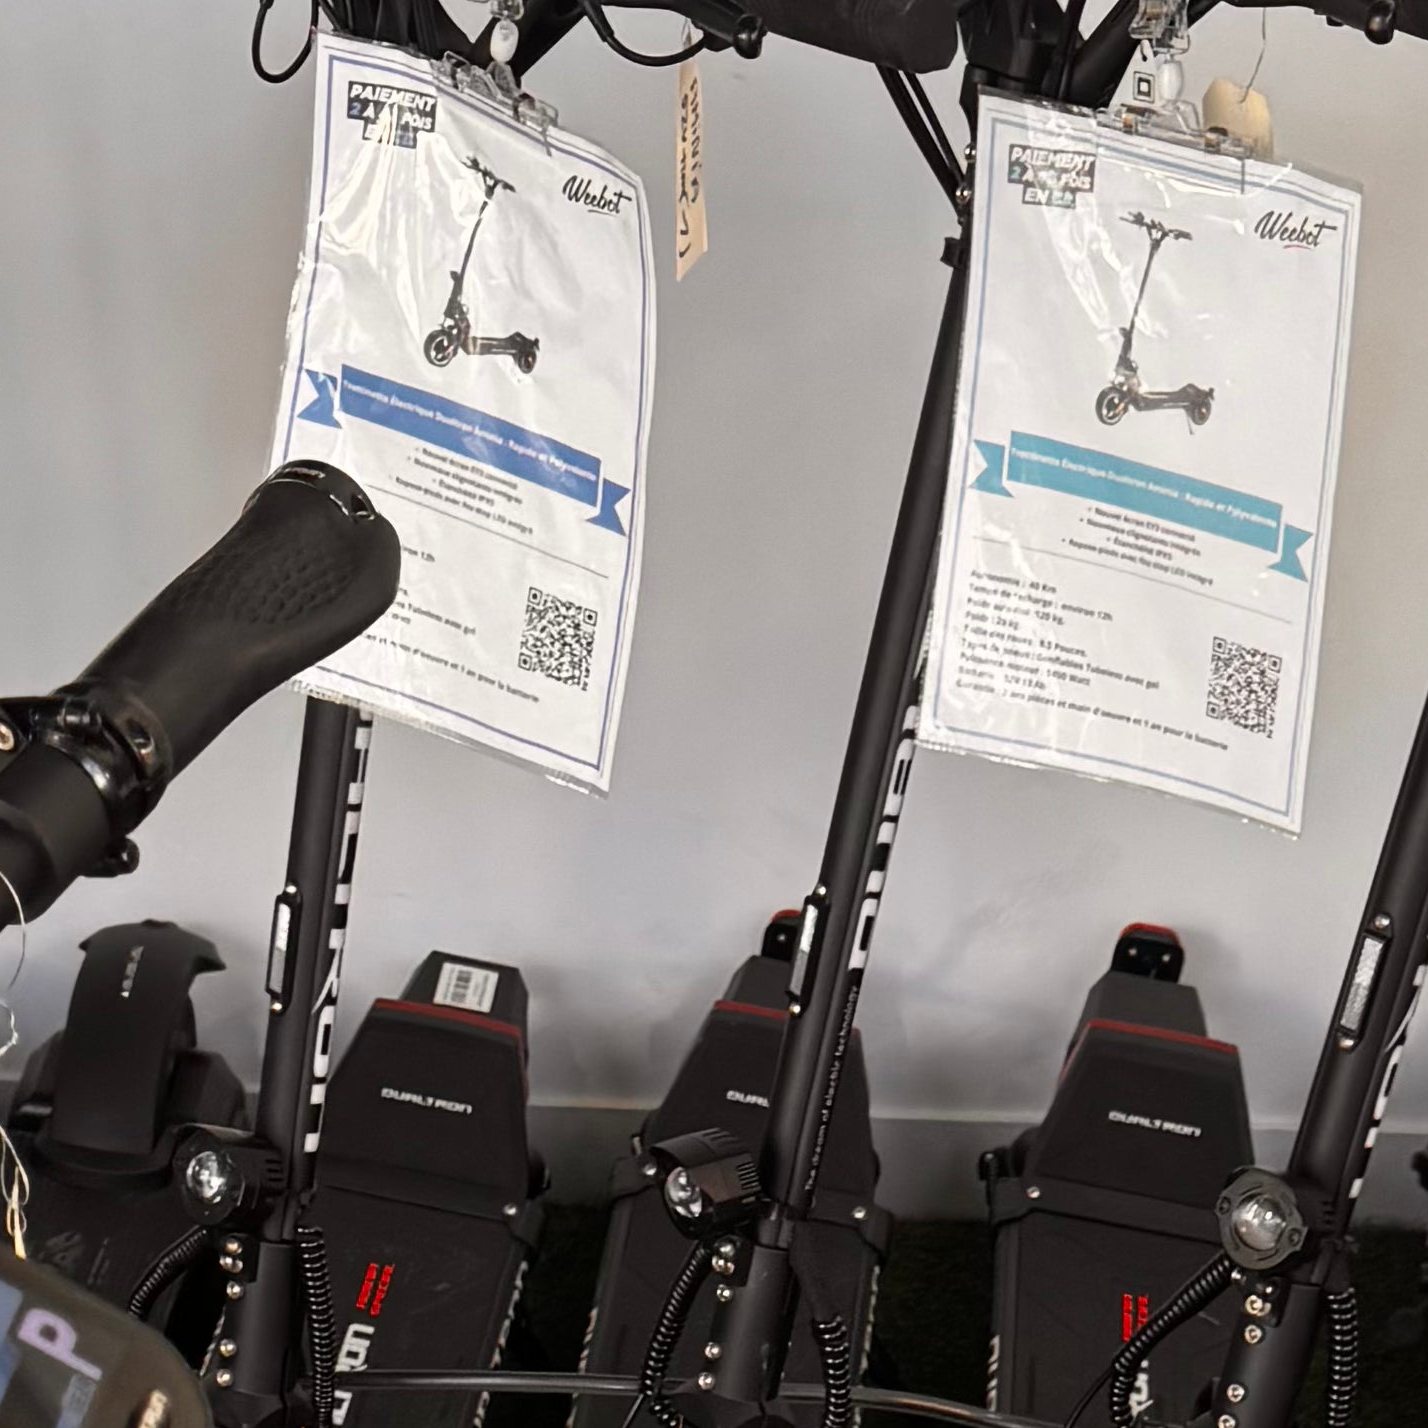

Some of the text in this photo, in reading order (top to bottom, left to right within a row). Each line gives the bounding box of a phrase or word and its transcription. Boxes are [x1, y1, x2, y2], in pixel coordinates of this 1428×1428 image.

[349, 84, 435, 112] PAIEMENT
[349, 102, 361, 116] 2
[1010, 165, 1020, 179] 2
[1011, 147, 1095, 171] PAIEMENT
[562, 175, 632, 214] Weebot
[1024, 188, 1048, 202] EN
[1254, 210, 1338, 247] Weebot
[381, 1087, 473, 1114] DUALTRON
[803, 986, 859, 1190] The dream of electric technology
[1108, 1110, 1202, 1137] DUALTRON
[17, 1308, 102, 1380] P
